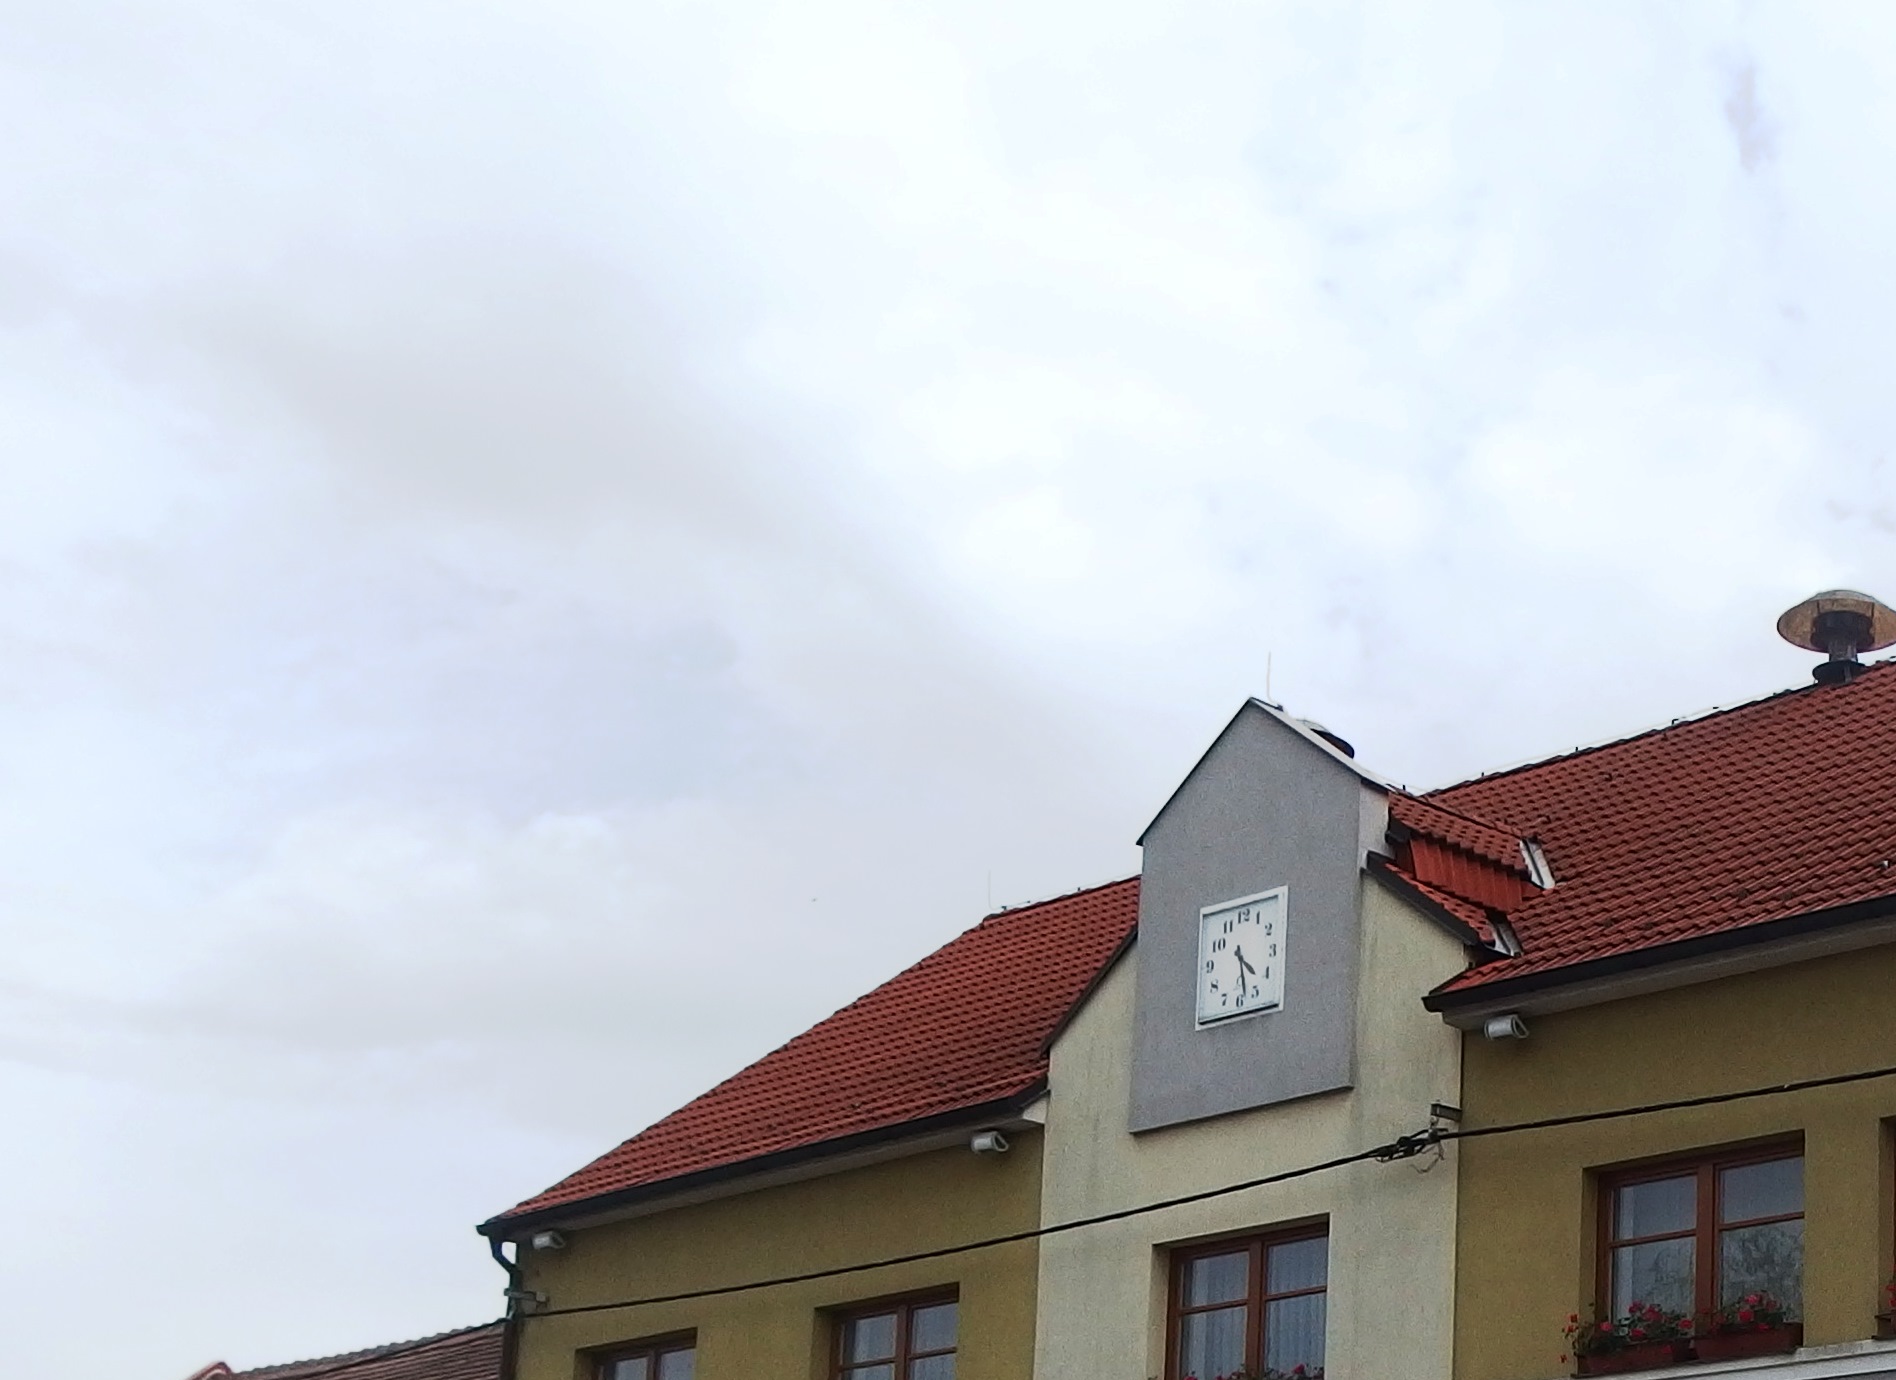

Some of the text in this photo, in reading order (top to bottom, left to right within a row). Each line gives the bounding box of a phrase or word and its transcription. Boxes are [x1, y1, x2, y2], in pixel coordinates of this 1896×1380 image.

[1237, 908, 1251, 924] 12
[1256, 910, 1261, 925] 1
[1223, 919, 1233, 934] 11
[1264, 922, 1273, 936] 2
[1212, 937, 1226, 953] 10
[1268, 943, 1277, 958] 3
[1206, 959, 1215, 974] 9
[1209, 978, 1219, 994] 8
[1251, 985, 1260, 999] 5
[1221, 993, 1228, 1007] 7
[1235, 994, 1244, 1008] 6
